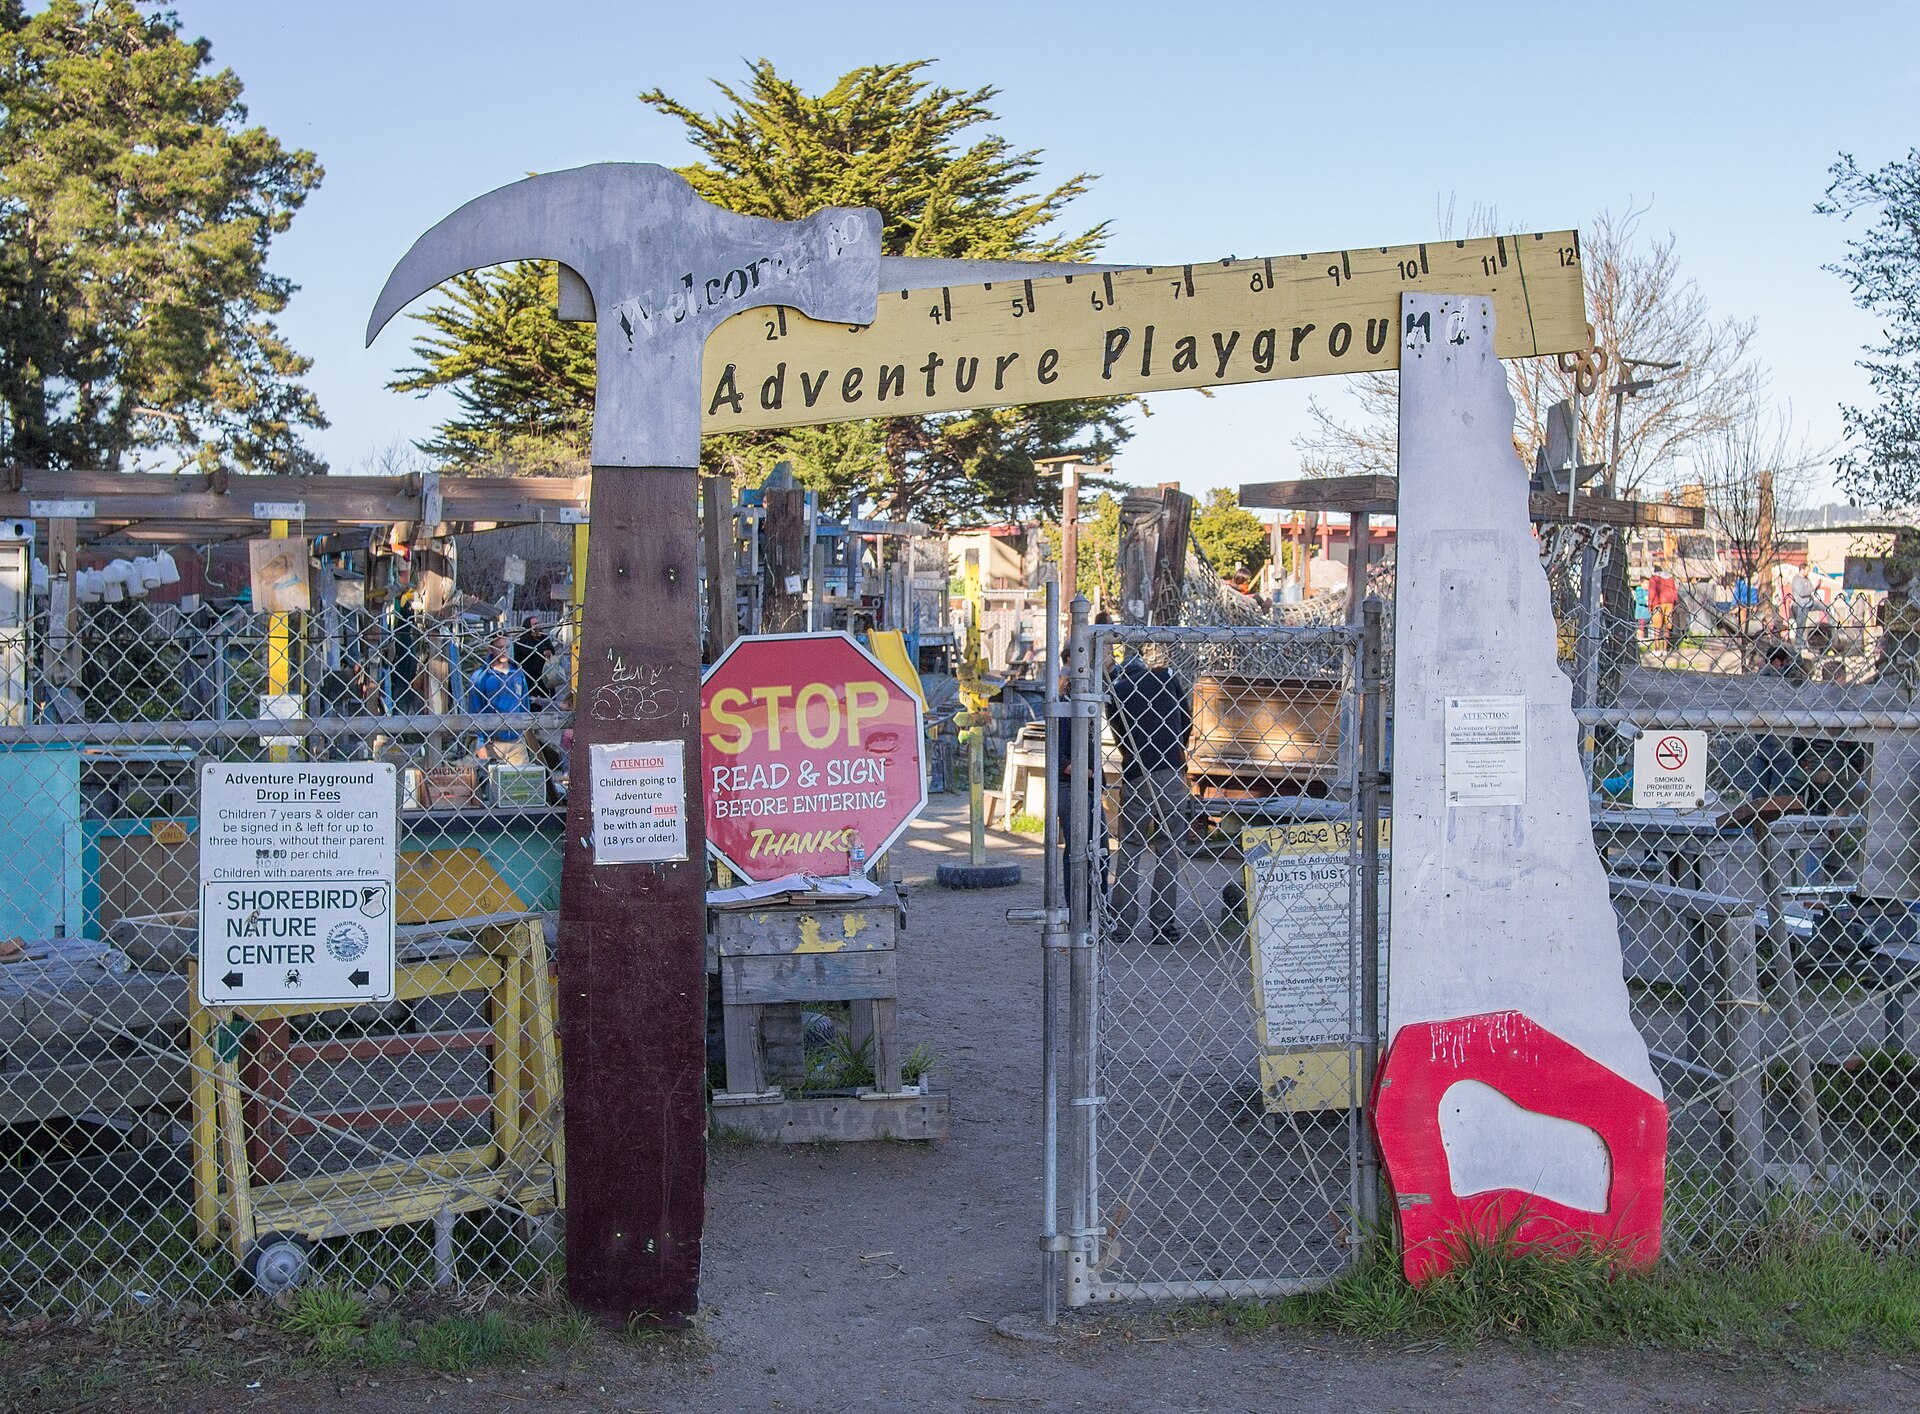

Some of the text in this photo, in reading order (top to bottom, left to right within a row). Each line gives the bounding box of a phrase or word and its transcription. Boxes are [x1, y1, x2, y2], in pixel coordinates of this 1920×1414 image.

[765, 248, 1576, 341] 2 4 5 6 7 8 9 10 11 12
[708, 348, 1059, 415] Adventure
[708, 681, 890, 754] STOP
[611, 758, 664, 769] ATTENTION
[225, 772, 374, 787] Adventure Playground
[712, 757, 887, 793] READ & SIGN
[600, 776, 677, 788] Children going to
[257, 789, 341, 802] Drop in Fees
[615, 792, 662, 801] Adventure
[715, 791, 887, 818] BEFORE ENTERING
[218, 809, 379, 822] Children 7 years & older can
[601, 805, 677, 817] Playground must
[223, 822, 374, 835] be signed in & left for up to
[603, 822, 615, 831] be
[617, 821, 637, 830] with
[653, 819, 676, 828] adult
[209, 836, 238, 846] three
[241, 836, 276, 846] hours,
[279, 835, 319, 846] without
[322, 835, 346, 846] their
[603, 836, 618, 847] (18
[620, 837, 634, 847] yrs
[648, 833, 678, 844] older).
[749, 828, 859, 859] THANKS
[290, 851, 309, 861] per
[312, 849, 341, 860] child.
[1257, 857, 1295, 867] Welome
[214, 868, 380, 878] Children with parents are free
[1311, 868, 1345, 880] MUST
[227, 889, 358, 910] SHOREBIRD
[226, 917, 317, 938] NATURE
[334, 920, 357, 930] MARINA
[226, 944, 316, 965] CENTER
[333, 954, 361, 963] PROGRAM
[1274, 978, 1285, 986] the
[1299, 1034, 1325, 1043] STAFF
